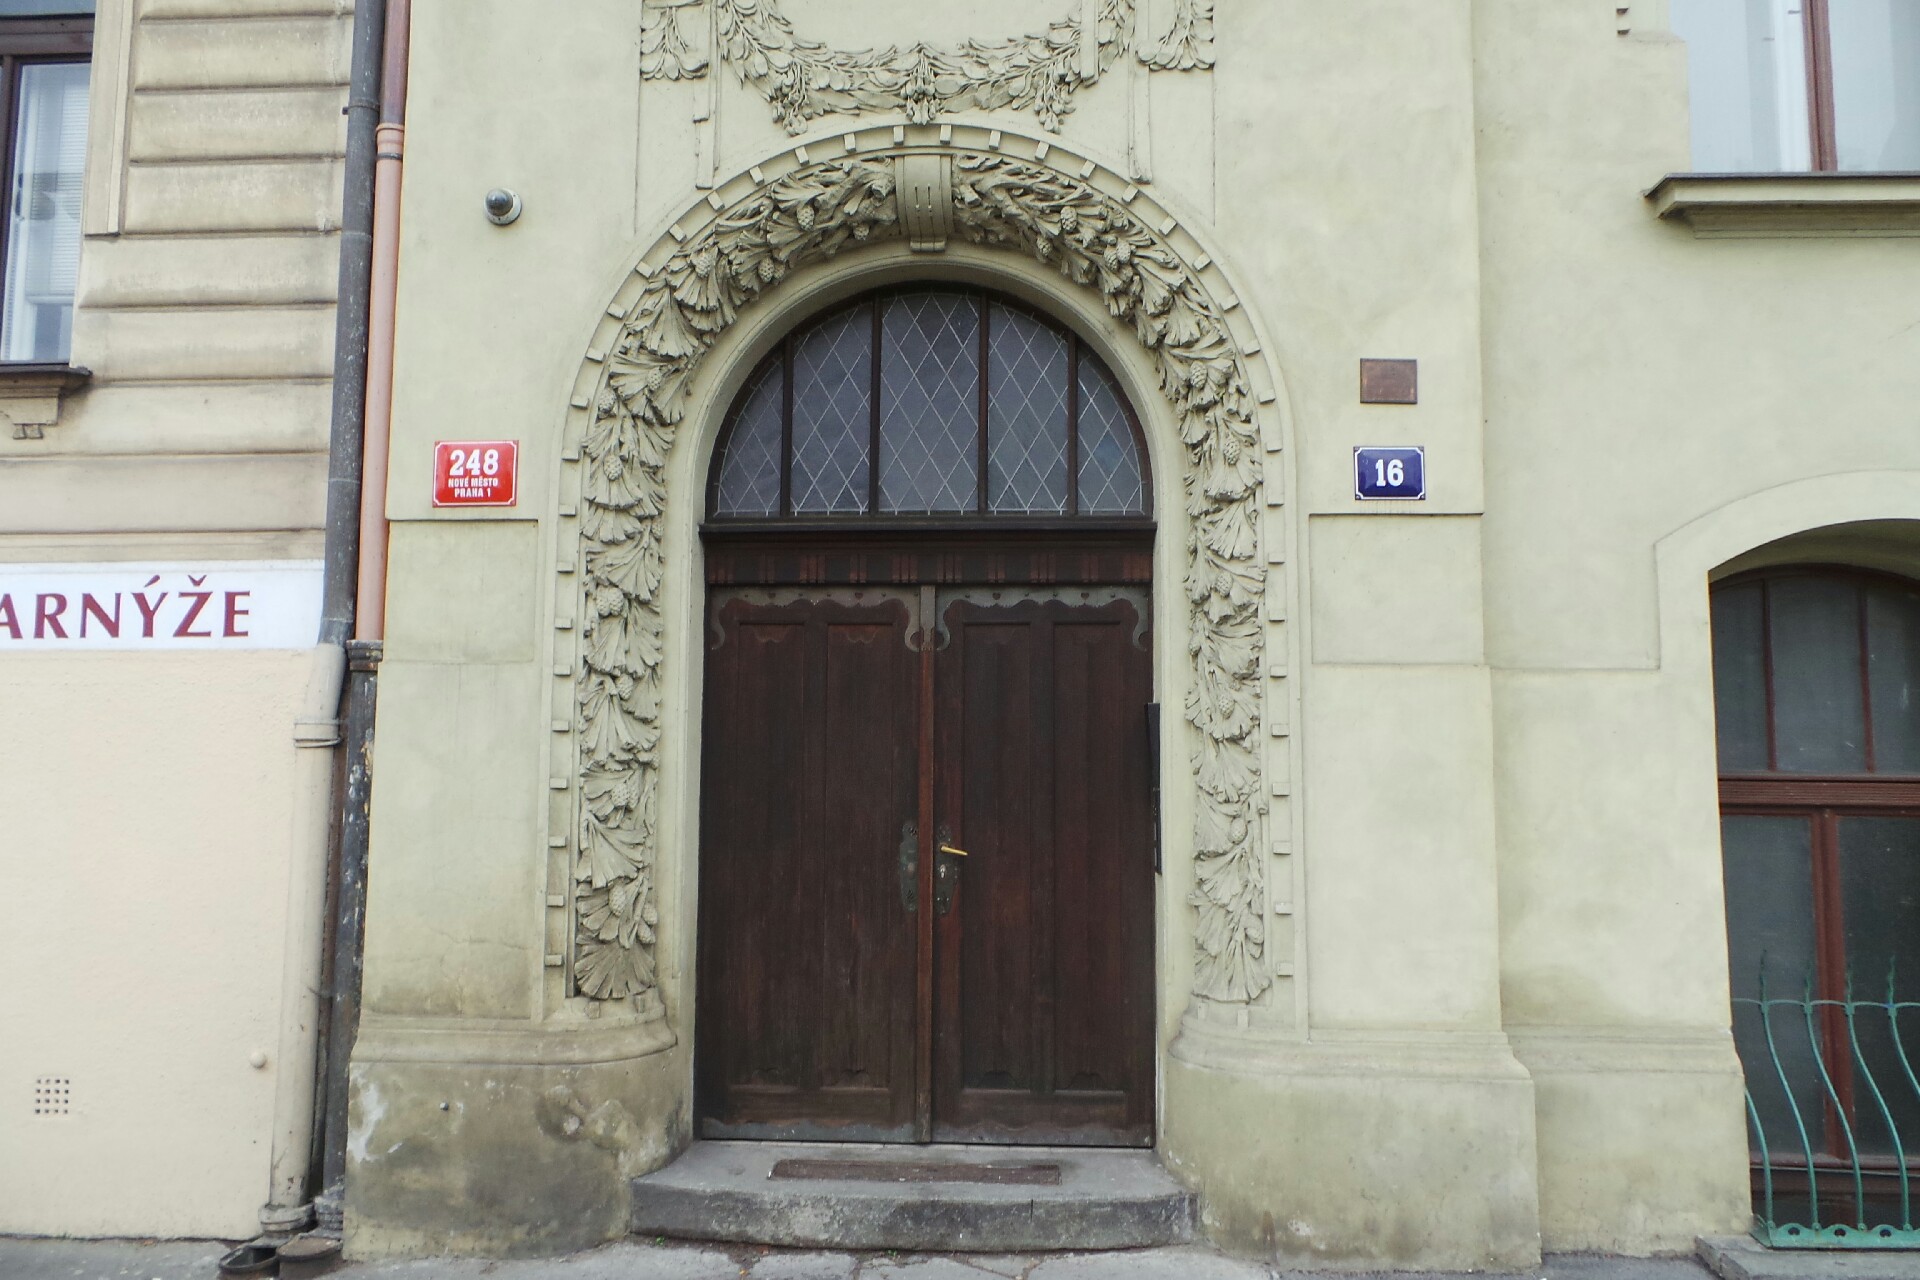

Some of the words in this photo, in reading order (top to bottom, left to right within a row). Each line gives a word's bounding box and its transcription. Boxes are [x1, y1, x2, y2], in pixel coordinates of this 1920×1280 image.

[450, 449, 499, 476] 248
[1375, 459, 1404, 487] 16
[448, 477, 469, 488] NOVÉ
[471, 476, 499, 487] MĚSTO
[454, 488, 484, 498] PRAHA
[487, 488, 491, 497] 1
[0, 574, 250, 639] ARNÝŽE
